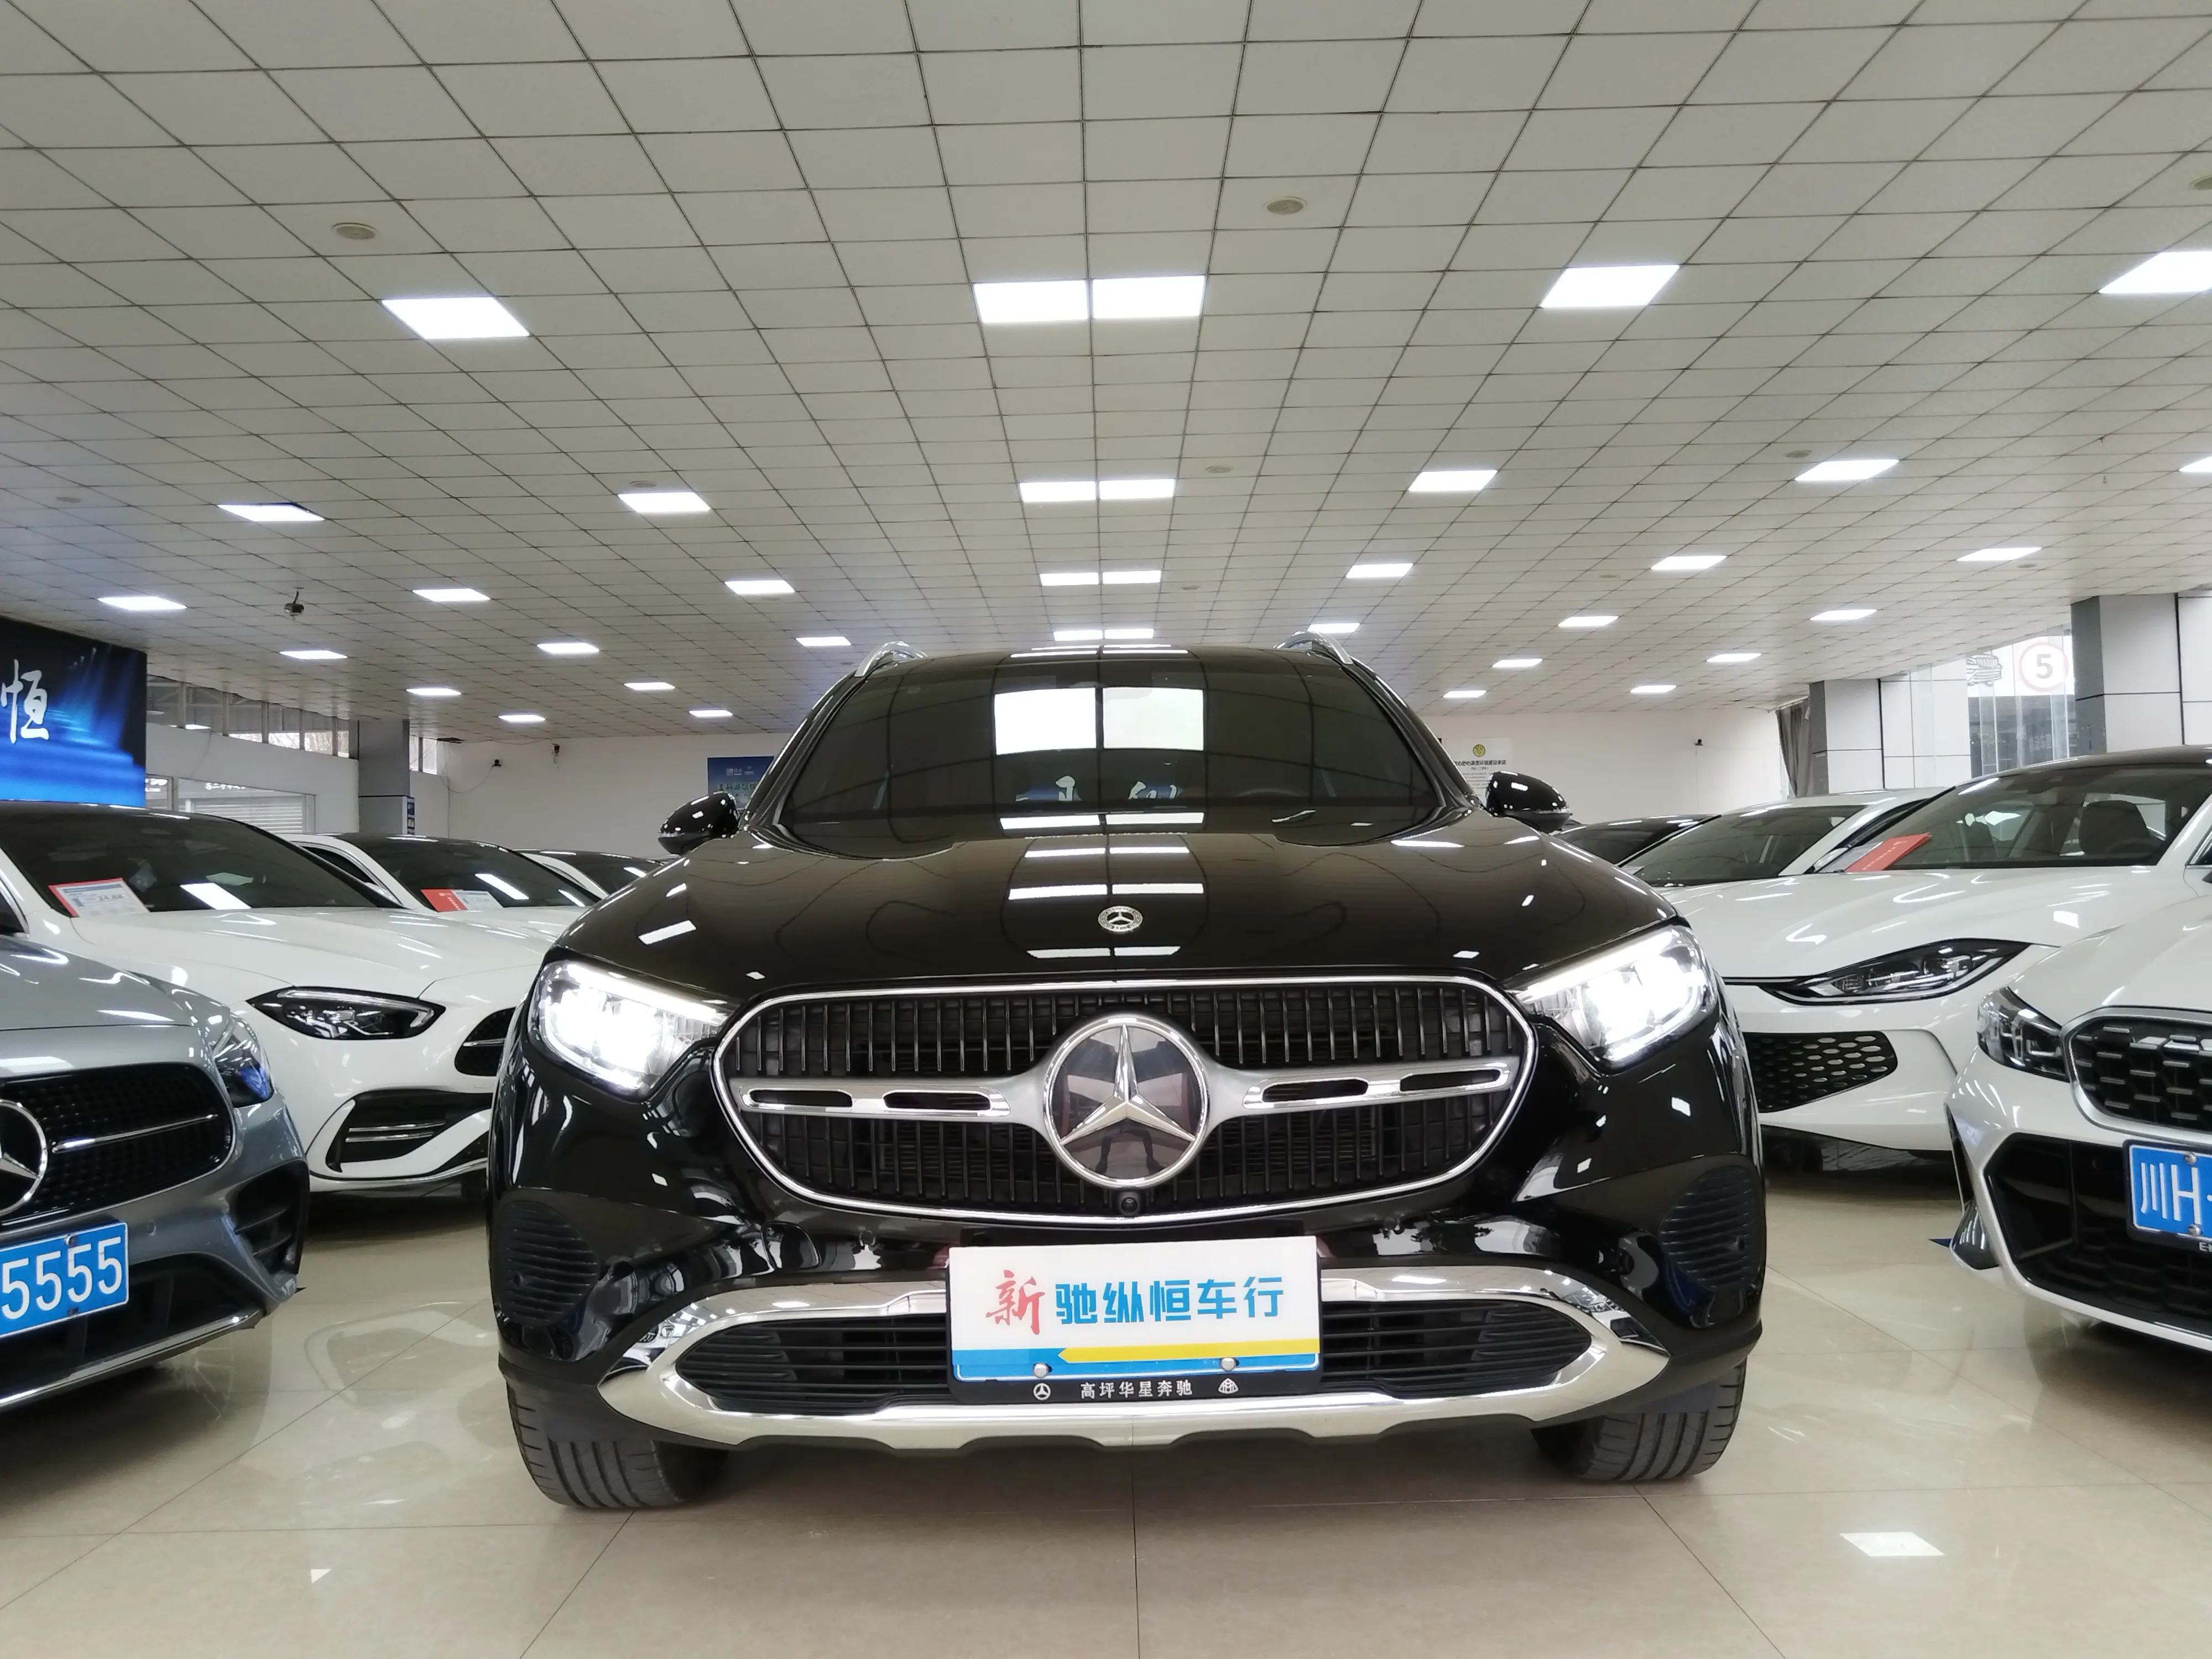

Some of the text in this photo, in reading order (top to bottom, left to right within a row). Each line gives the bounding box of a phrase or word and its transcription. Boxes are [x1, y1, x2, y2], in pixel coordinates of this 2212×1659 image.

[2036, 653, 2053, 679] 5
[1, 659, 49, 744] 恒
[2, 1236, 122, 1319] 5555
[1080, 1380, 1193, 1399] 高坪华星奔驰
